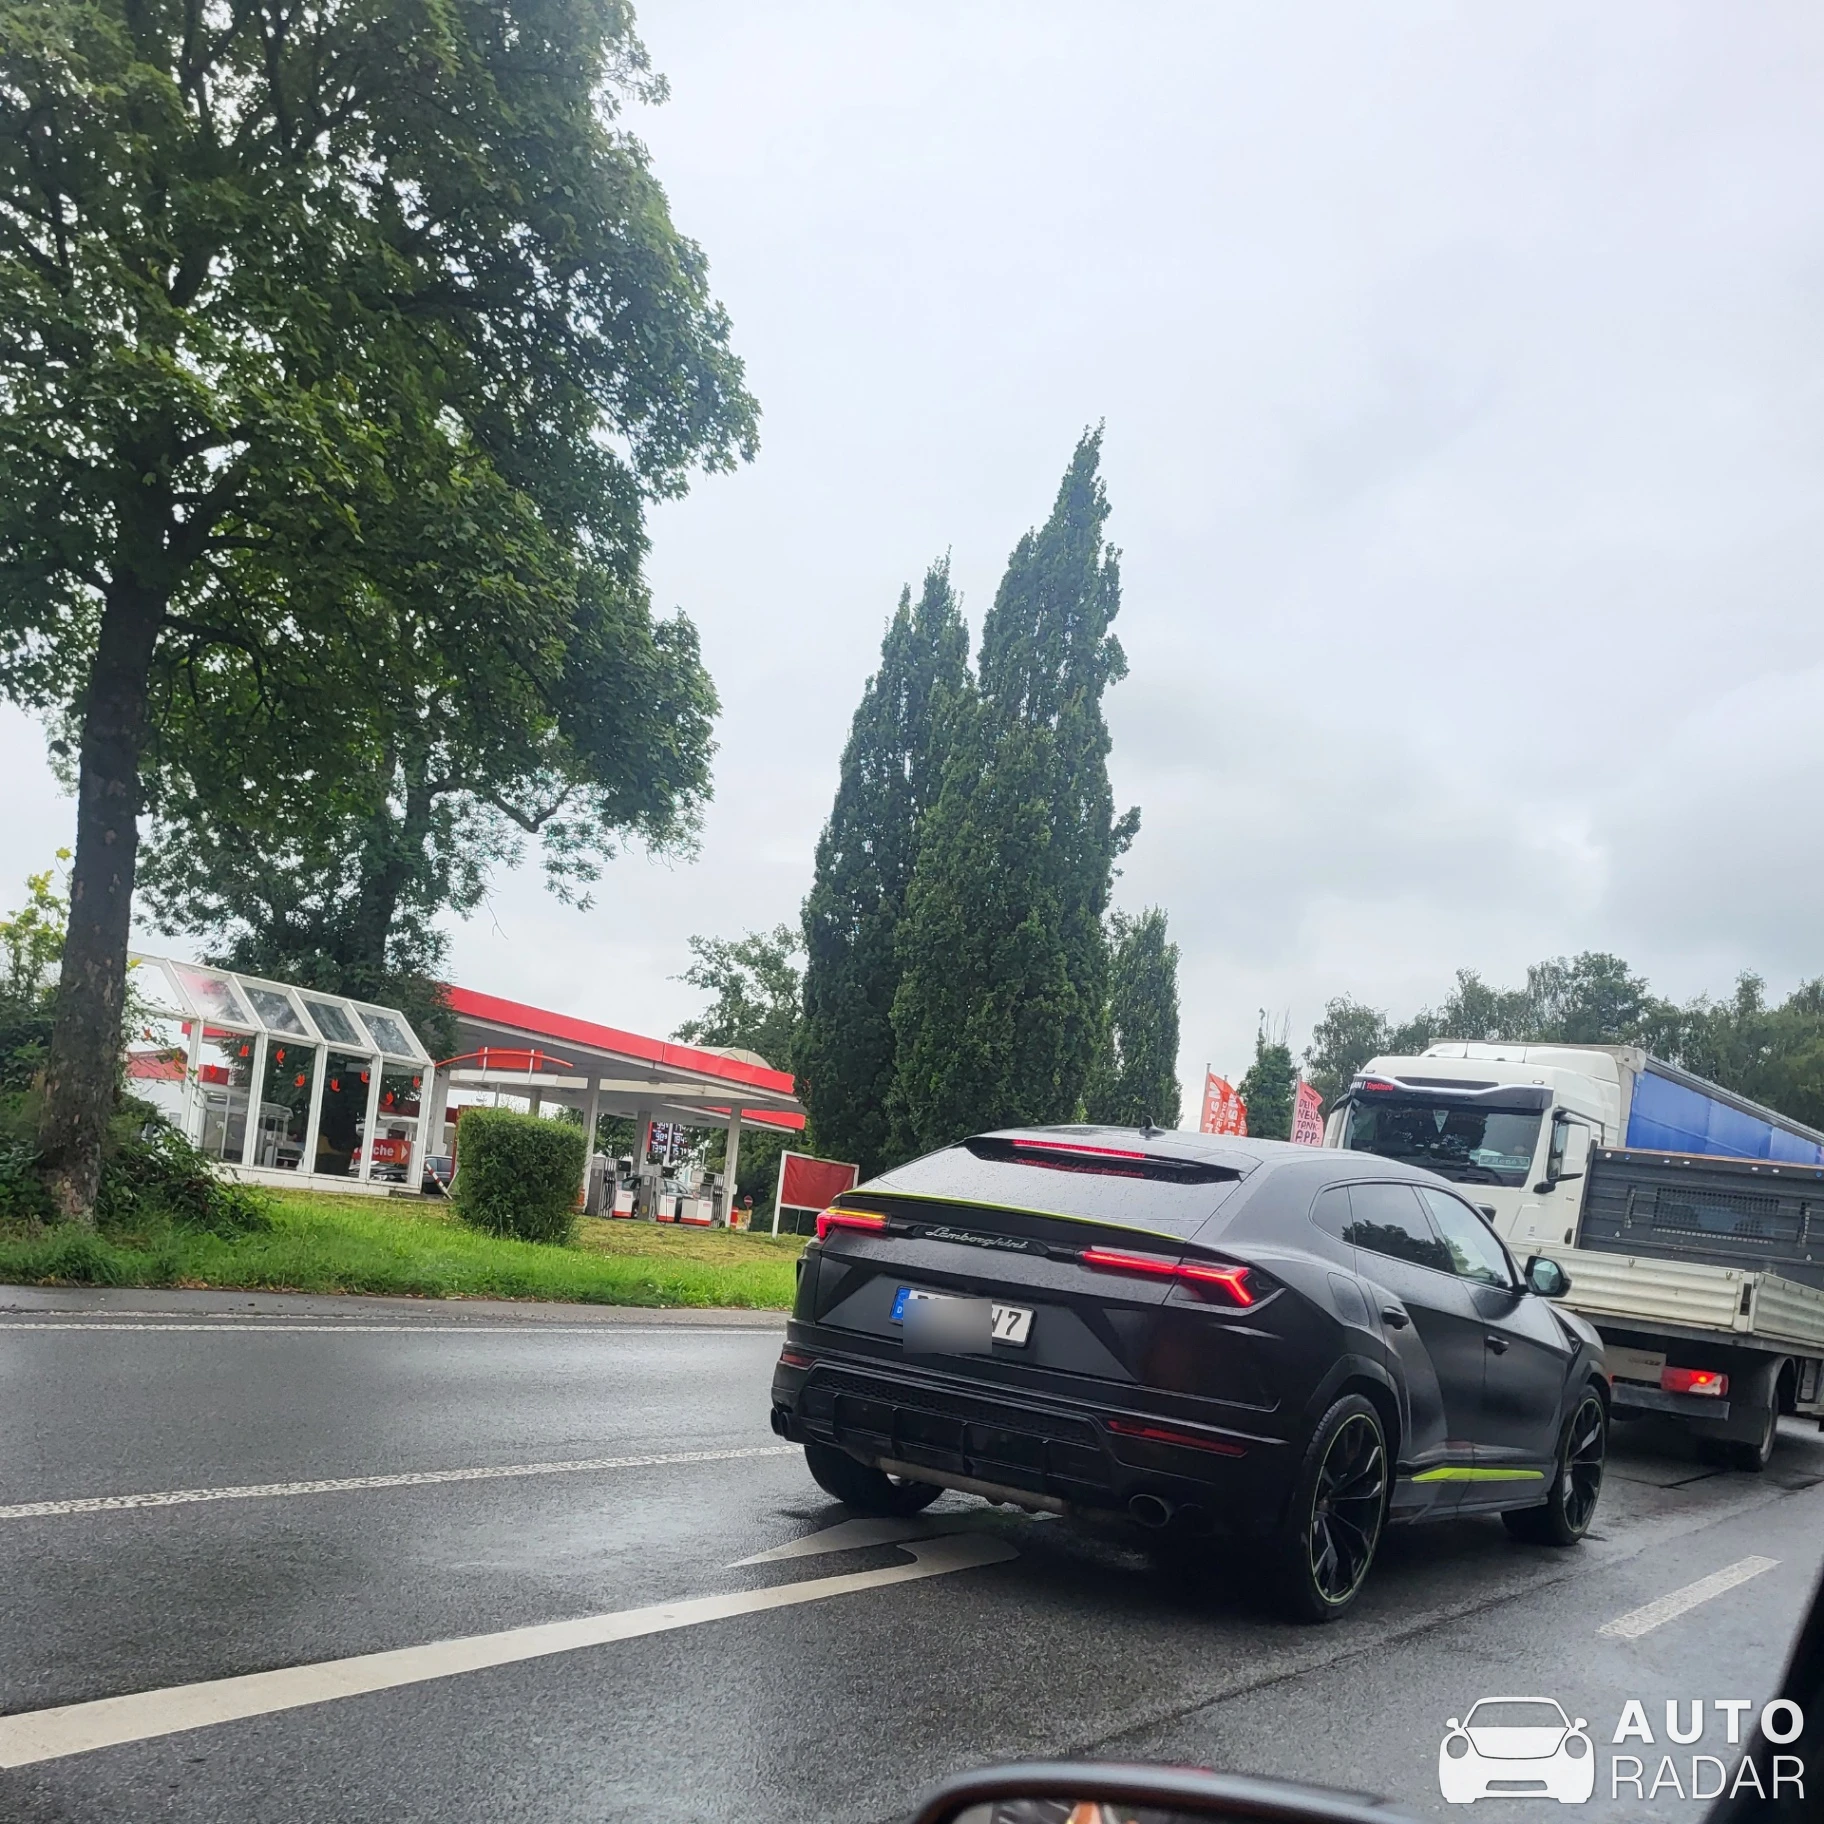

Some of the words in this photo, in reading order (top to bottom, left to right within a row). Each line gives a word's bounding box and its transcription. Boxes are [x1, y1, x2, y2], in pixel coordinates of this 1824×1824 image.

[1298, 1098, 1316, 1110] DEIN
[1297, 1109, 1321, 1122] NEUE
[925, 1227, 1028, 1249] Lamborghini
